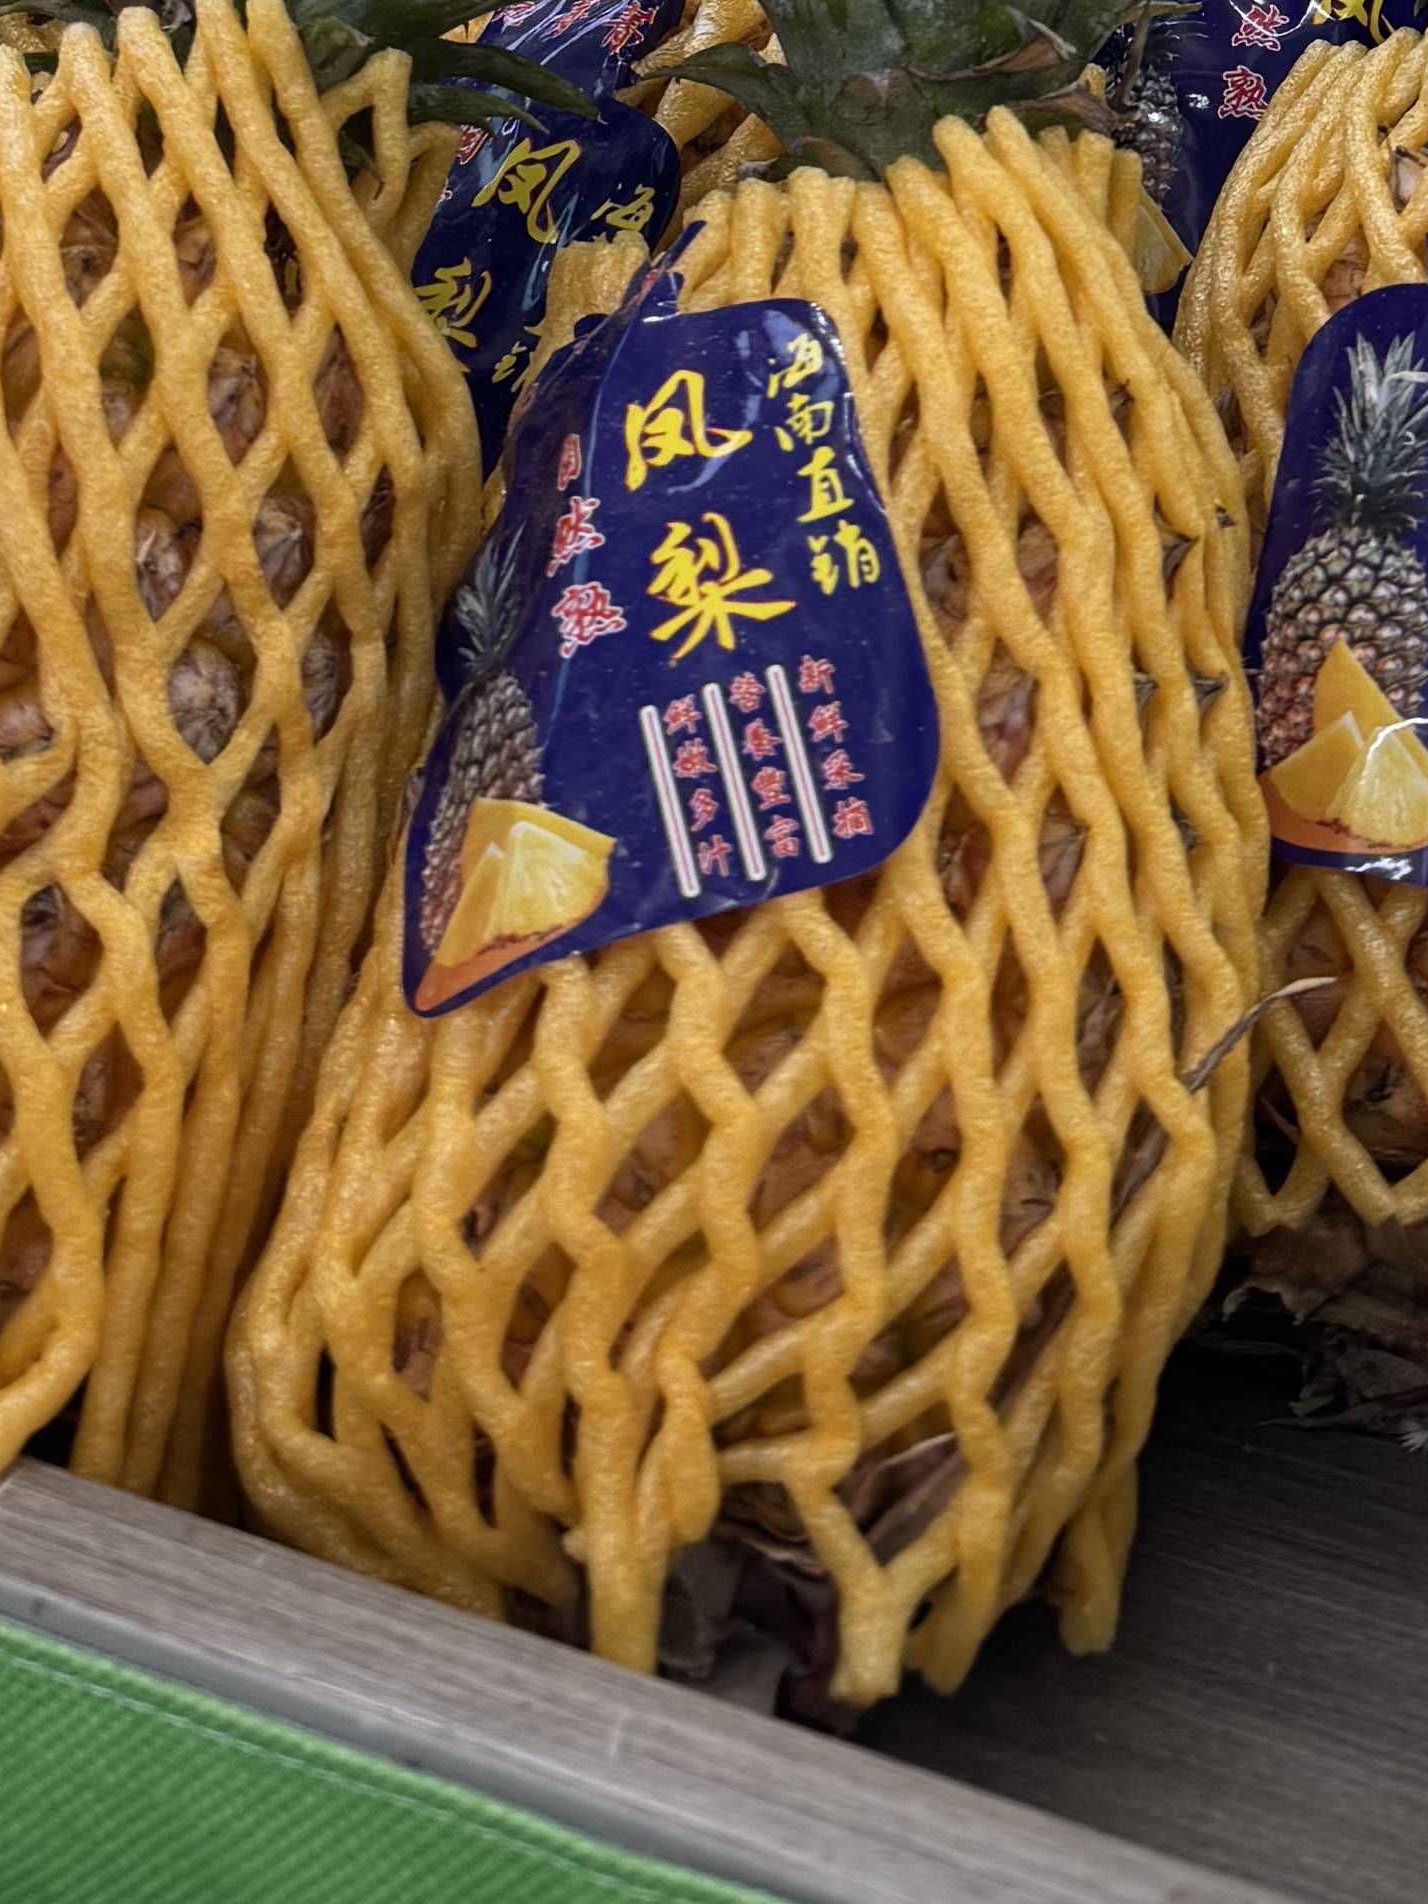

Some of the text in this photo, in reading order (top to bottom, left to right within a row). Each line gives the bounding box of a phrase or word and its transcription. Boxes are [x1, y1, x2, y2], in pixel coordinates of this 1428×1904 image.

[624, 370, 797, 667] 凤梨
[767, 333, 880, 596] 海南直销
